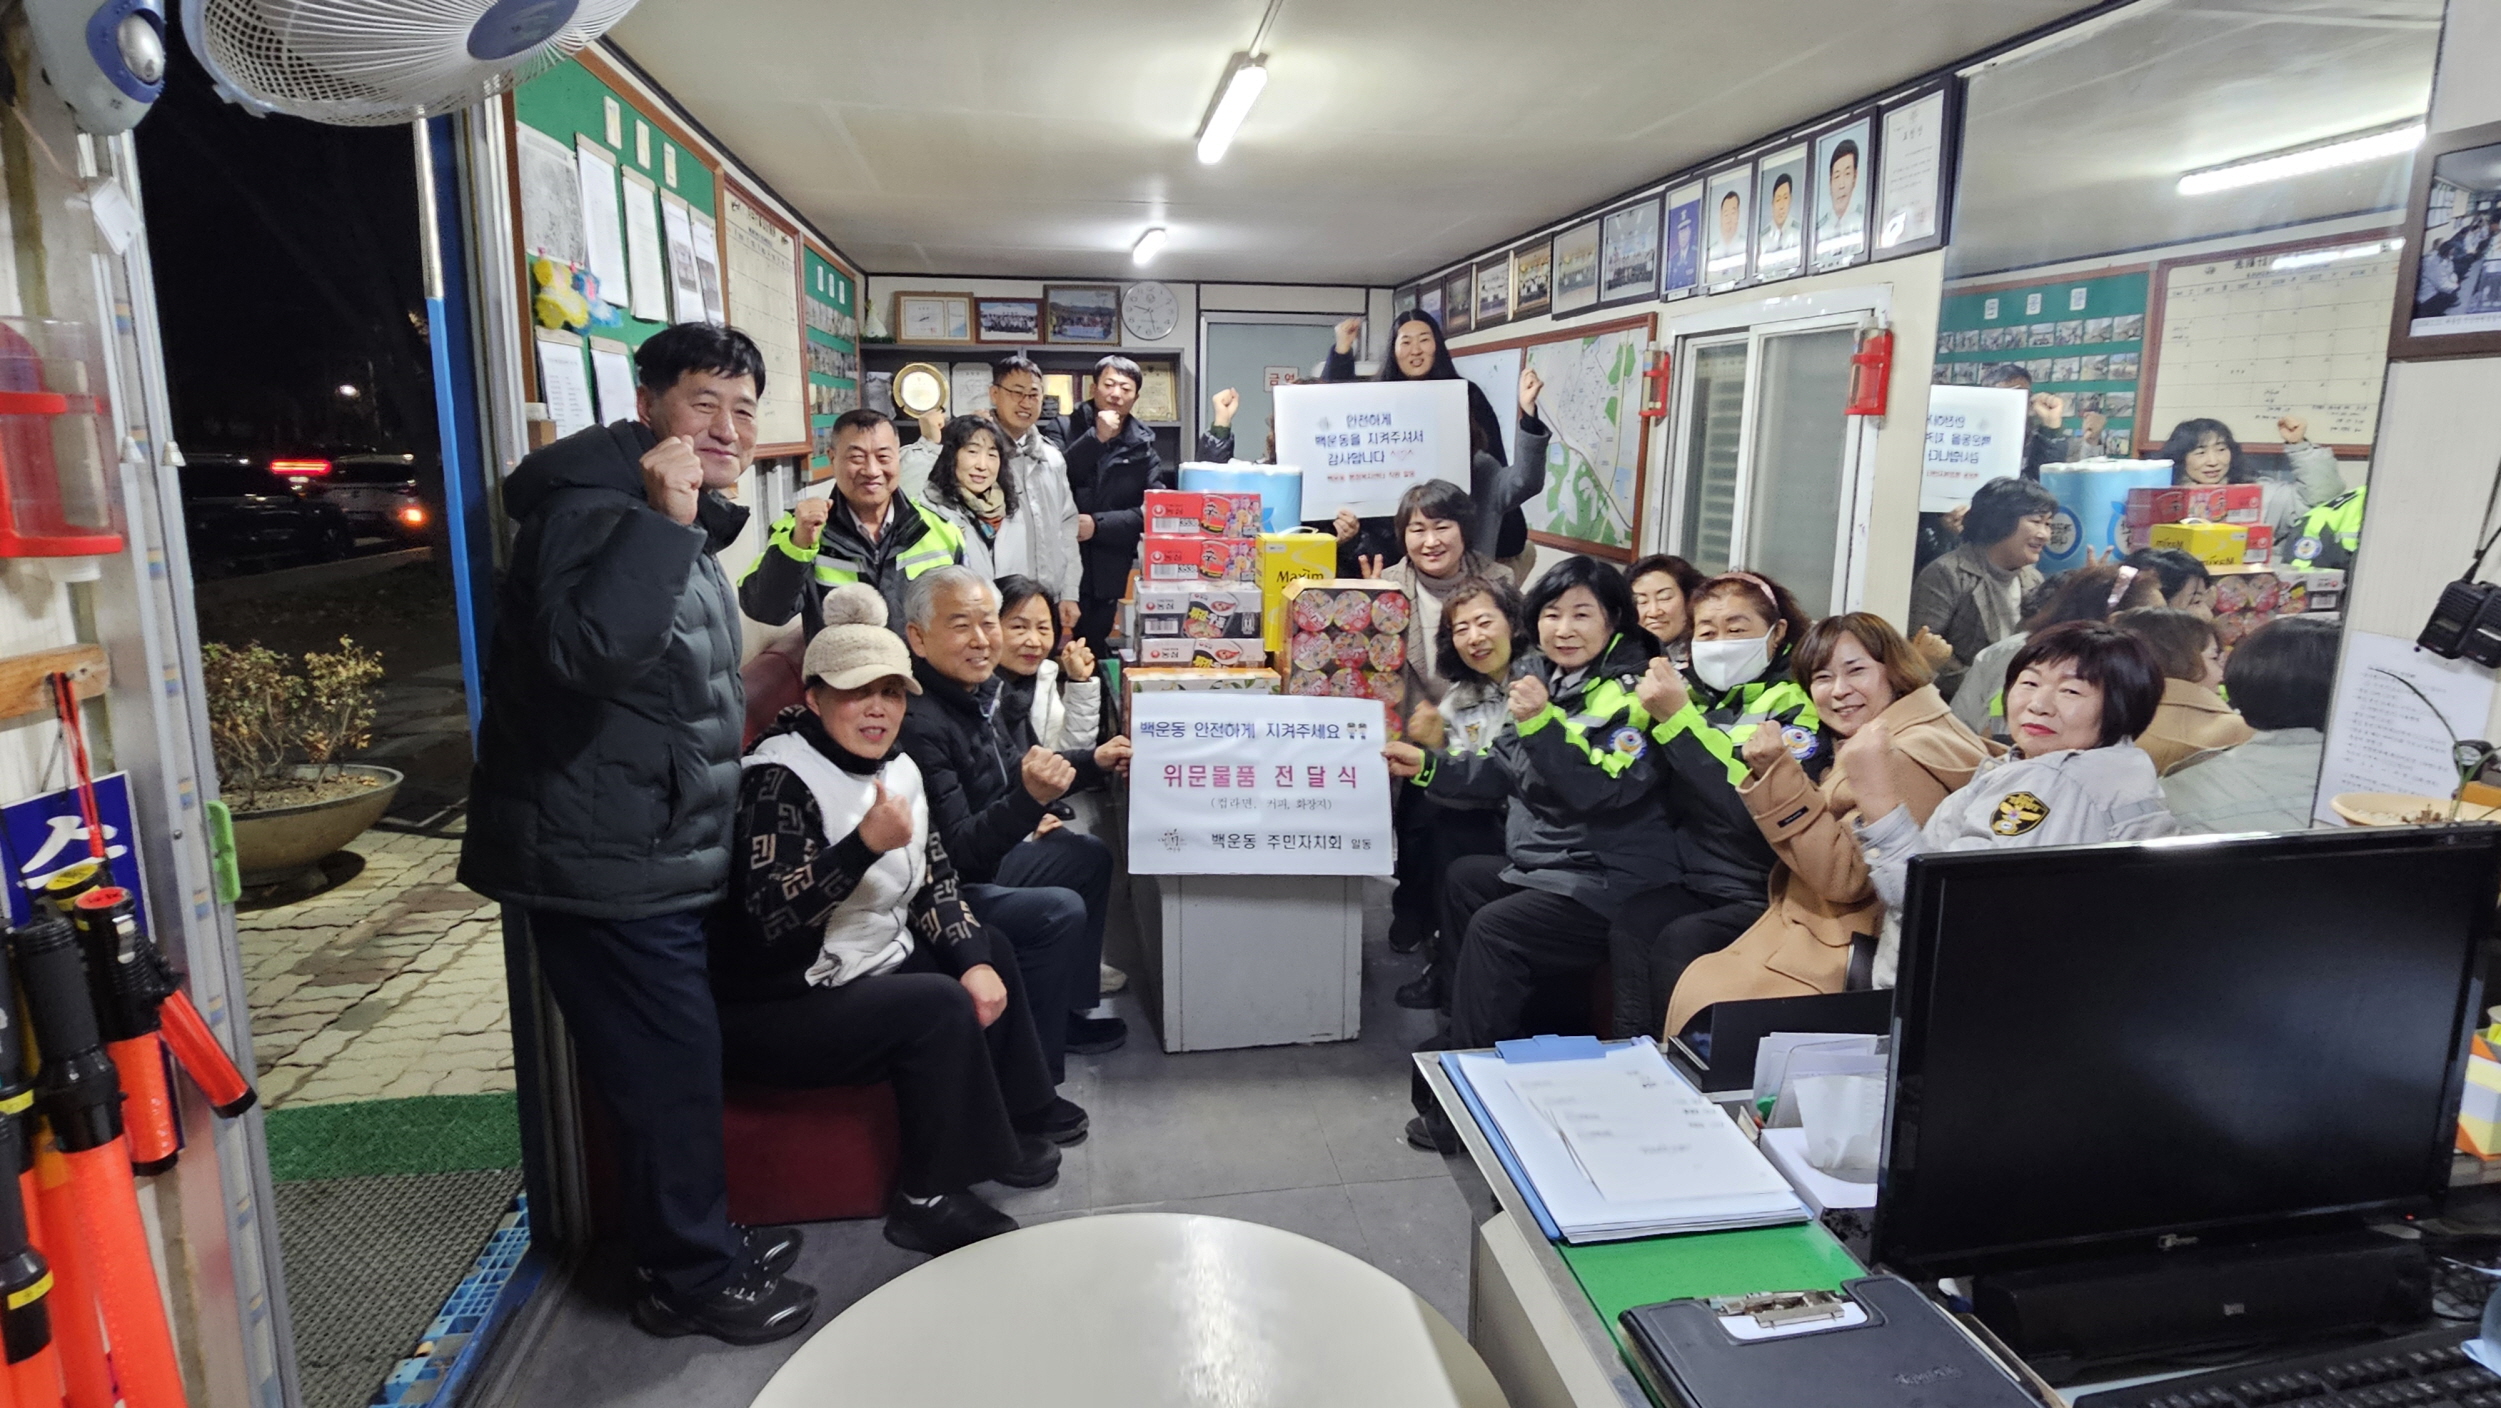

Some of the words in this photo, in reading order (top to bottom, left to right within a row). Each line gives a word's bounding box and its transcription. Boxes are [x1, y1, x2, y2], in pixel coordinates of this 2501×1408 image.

[1346, 412, 1391, 428] 안전하게
[1315, 433, 1360, 447] 백운동을
[1368, 430, 1424, 444] 지켜주셔서
[1328, 450, 1385, 466] 감사합니다
[1140, 721, 1185, 738] 백운동
[1194, 721, 1255, 739] 안전하게
[1266, 722, 1340, 740] 지켜주세요
[1163, 764, 1256, 788] 위문물품
[1296, 798, 1333, 811] 화장지)
[1211, 832, 1257, 850] 백운동
[1267, 833, 1342, 850] 주민자치회
[1351, 838, 1372, 850] 일동
